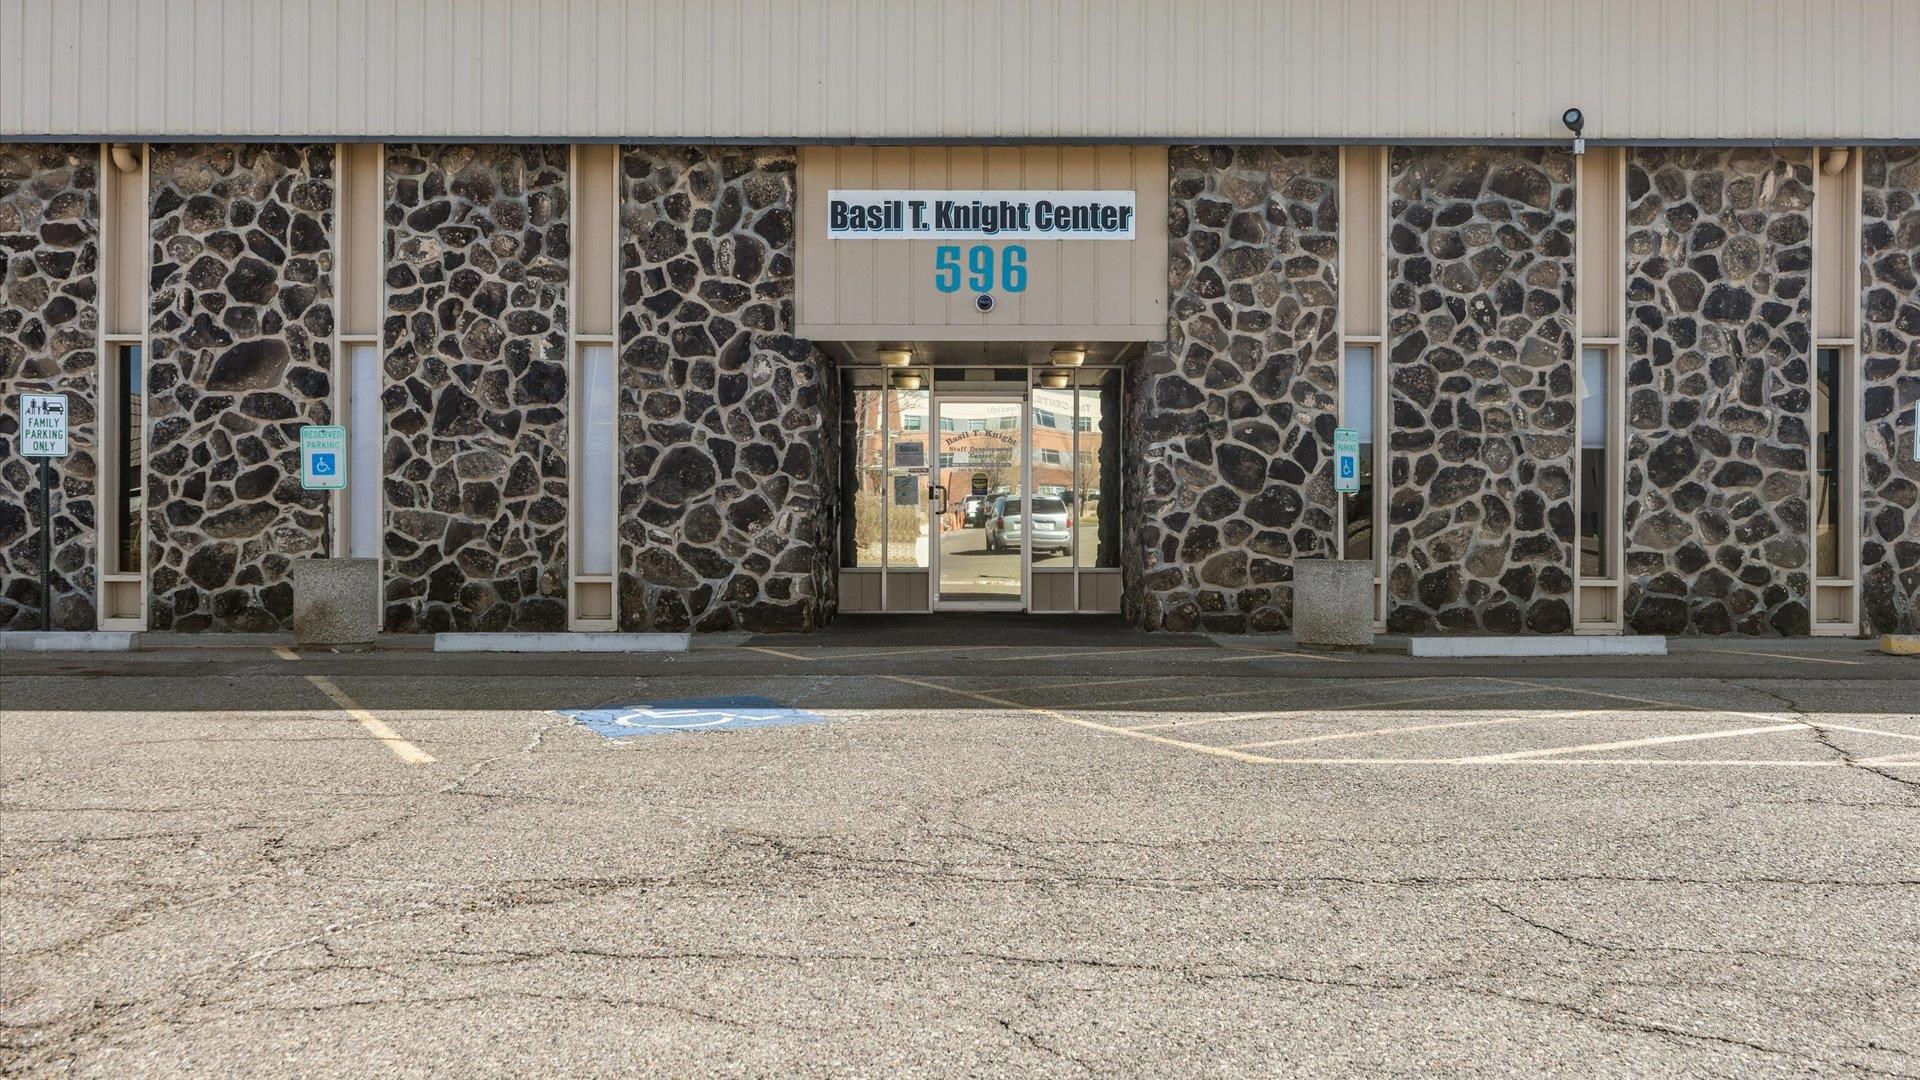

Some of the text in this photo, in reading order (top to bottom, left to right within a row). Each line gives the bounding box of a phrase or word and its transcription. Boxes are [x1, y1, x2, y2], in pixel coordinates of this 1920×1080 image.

[830, 200, 1133, 235] Basil T. Knight Center
[936, 245, 1027, 293] 596
[28, 418, 59, 427] FAMILY
[25, 430, 63, 439] PARKING
[945, 431, 969, 446] Basil
[985, 430, 1017, 446] Knight
[33, 441, 55, 451] ONLY
